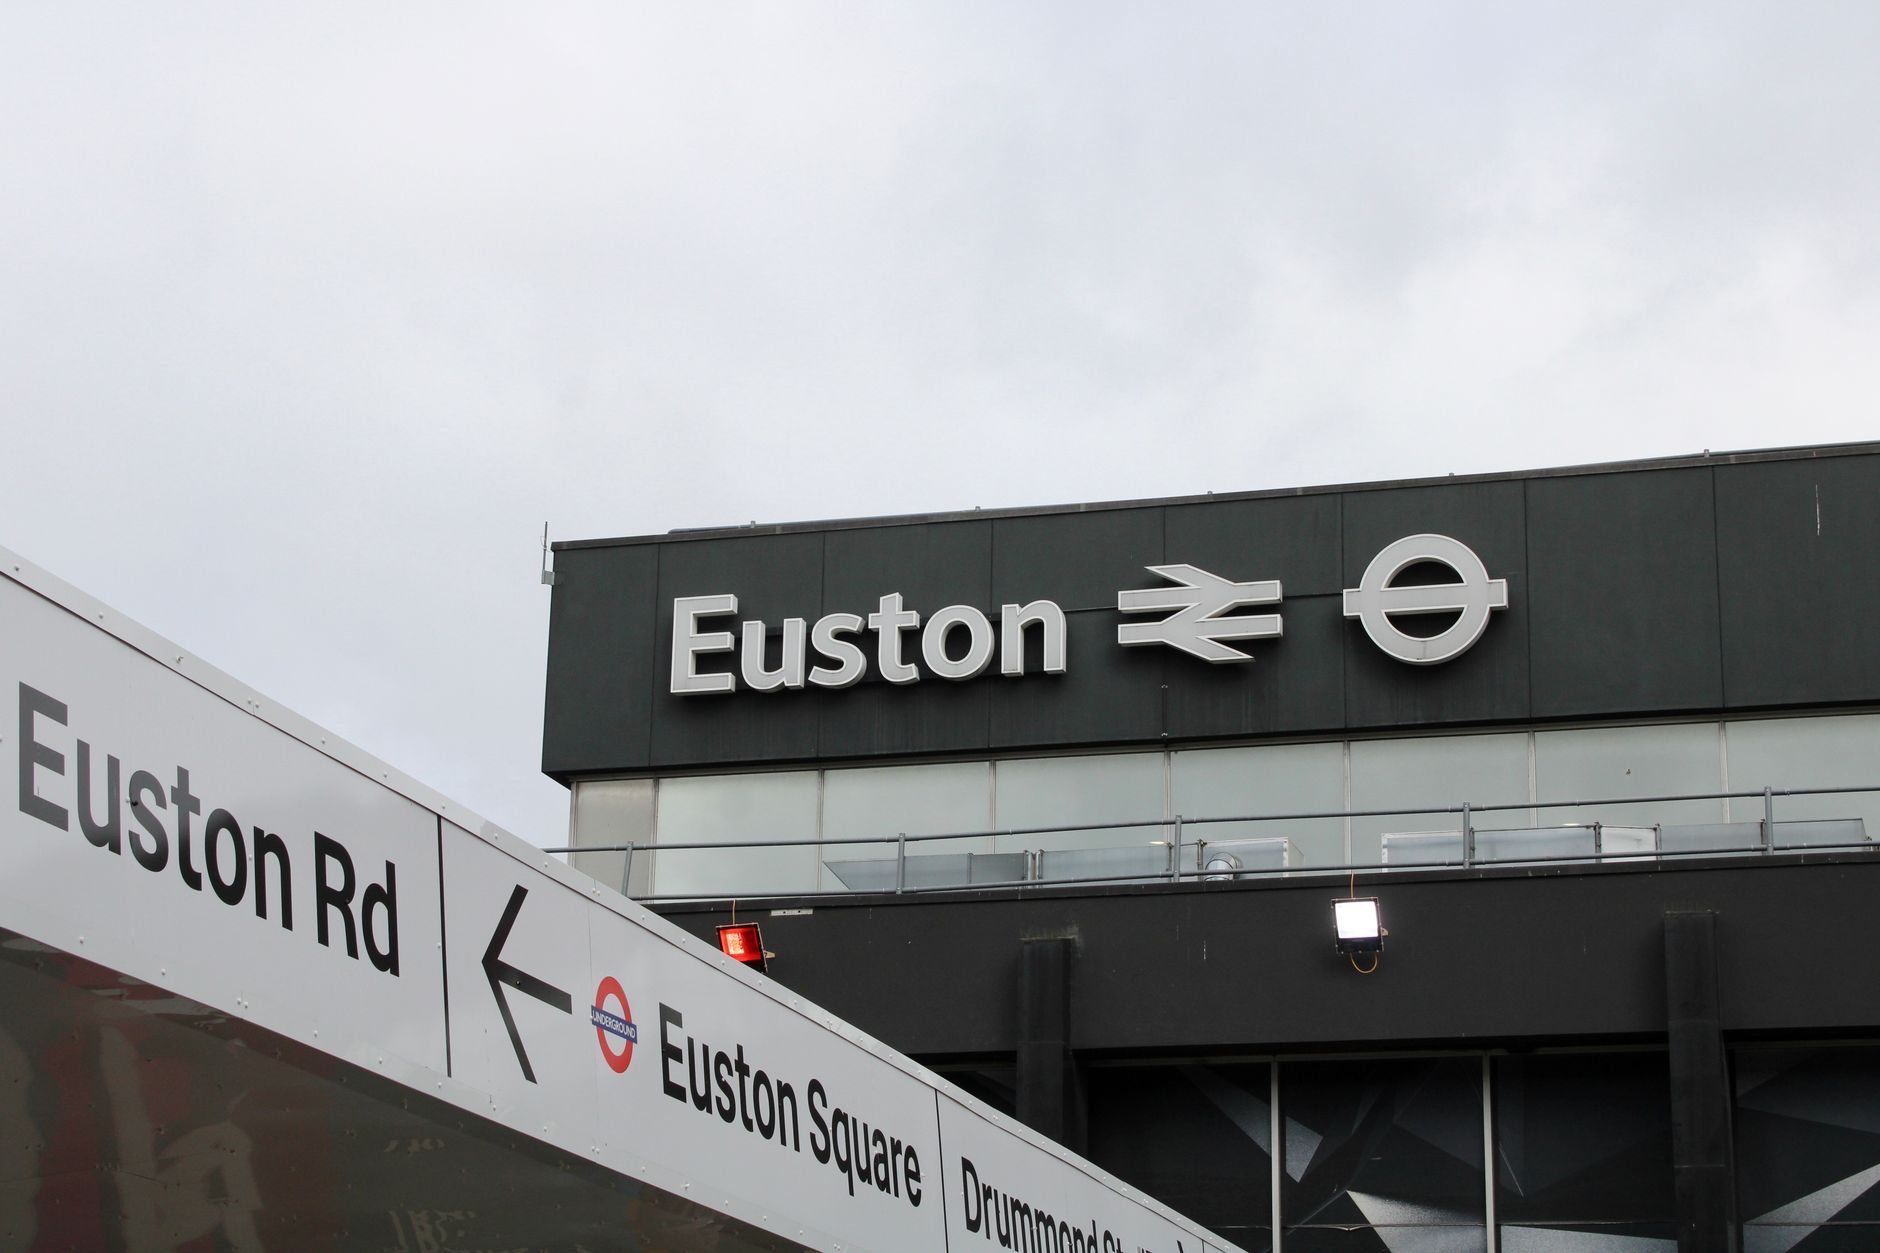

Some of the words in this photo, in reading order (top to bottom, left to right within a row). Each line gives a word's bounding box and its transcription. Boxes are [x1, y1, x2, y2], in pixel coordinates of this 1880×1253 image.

[670, 593, 1068, 696] Euston
[19, 681, 293, 932] Euston
[314, 831, 400, 977] Rd
[592, 1010, 636, 1039] UNDERGROUND
[659, 1003, 800, 1152] Euston
[807, 1078, 922, 1207] Square
